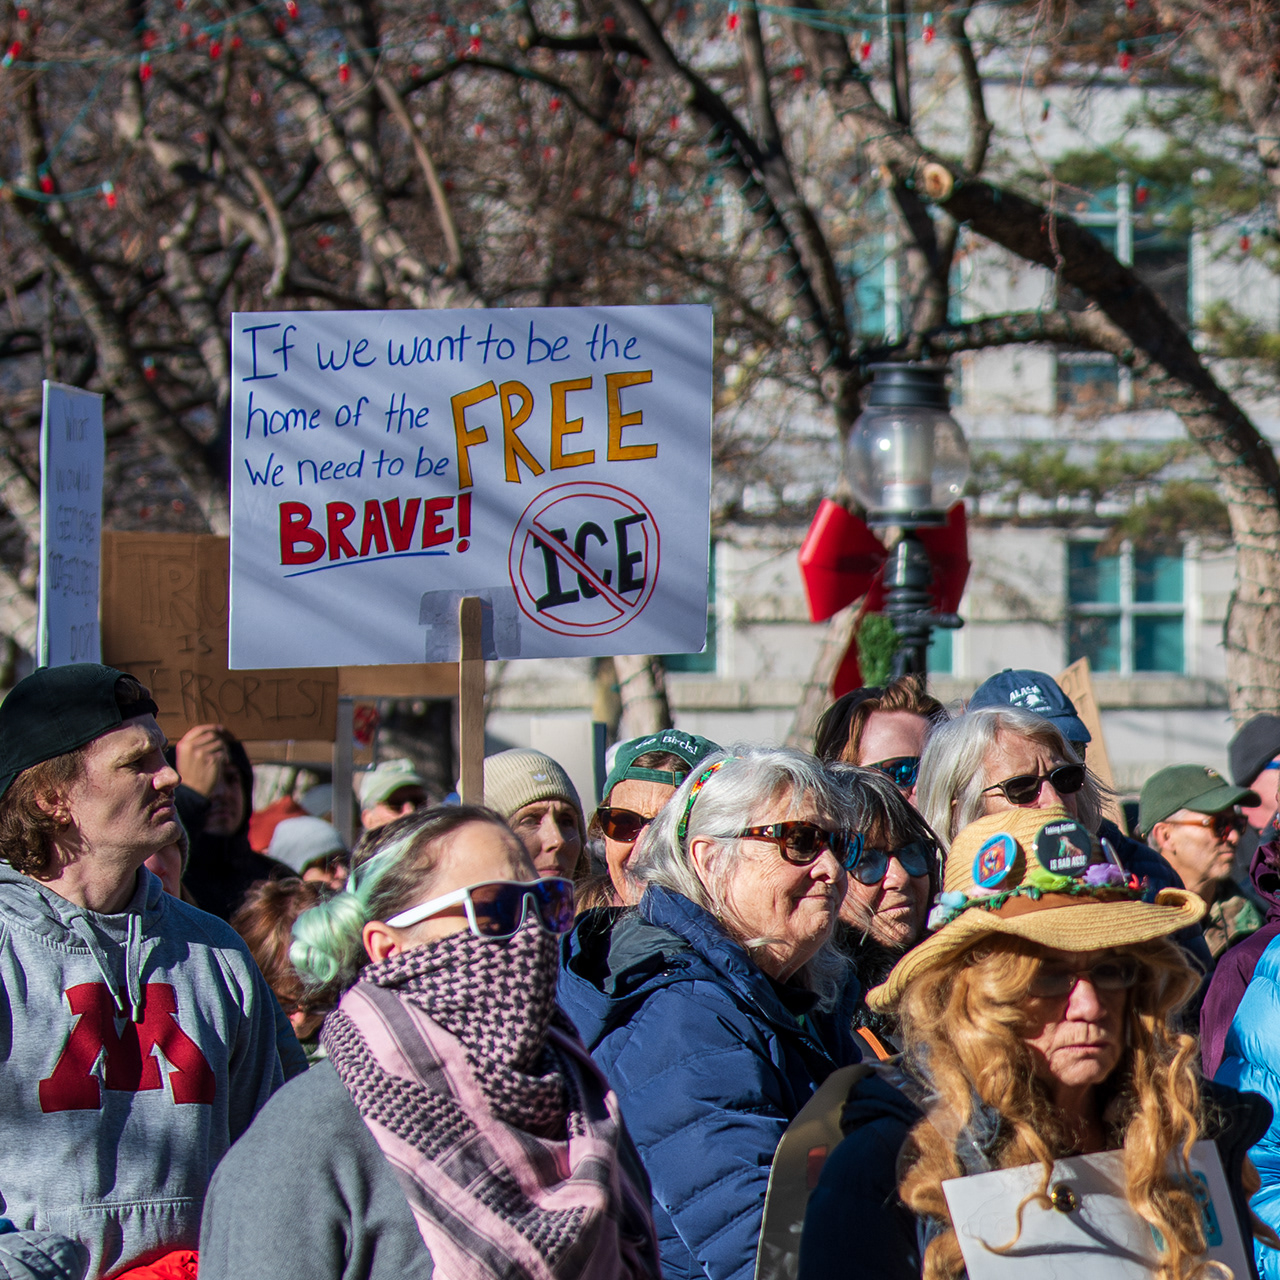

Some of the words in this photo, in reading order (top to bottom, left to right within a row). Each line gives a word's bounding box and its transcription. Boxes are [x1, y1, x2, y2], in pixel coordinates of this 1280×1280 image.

[242, 323, 296, 382] If
[317, 336, 376, 371] we
[388, 325, 473, 366] want
[476, 323, 515, 364] to
[527, 320, 571, 364] be
[586, 323, 642, 362] the
[244, 392, 321, 439] home
[334, 397, 368, 428] of
[385, 393, 430, 433] the
[450, 370, 658, 490] FREE
[244, 452, 284, 487] We
[298, 449, 365, 483] need
[372, 448, 404, 479] to
[415, 446, 450, 478] be
[279, 492, 473, 565] BRAVE!
[532, 513, 648, 612] ICE
[116, 541, 228, 630] TRU
[1009, 685, 1041, 702] ALASK
[662, 735, 698, 755] Birds!
[39, 982, 215, 1113] M
